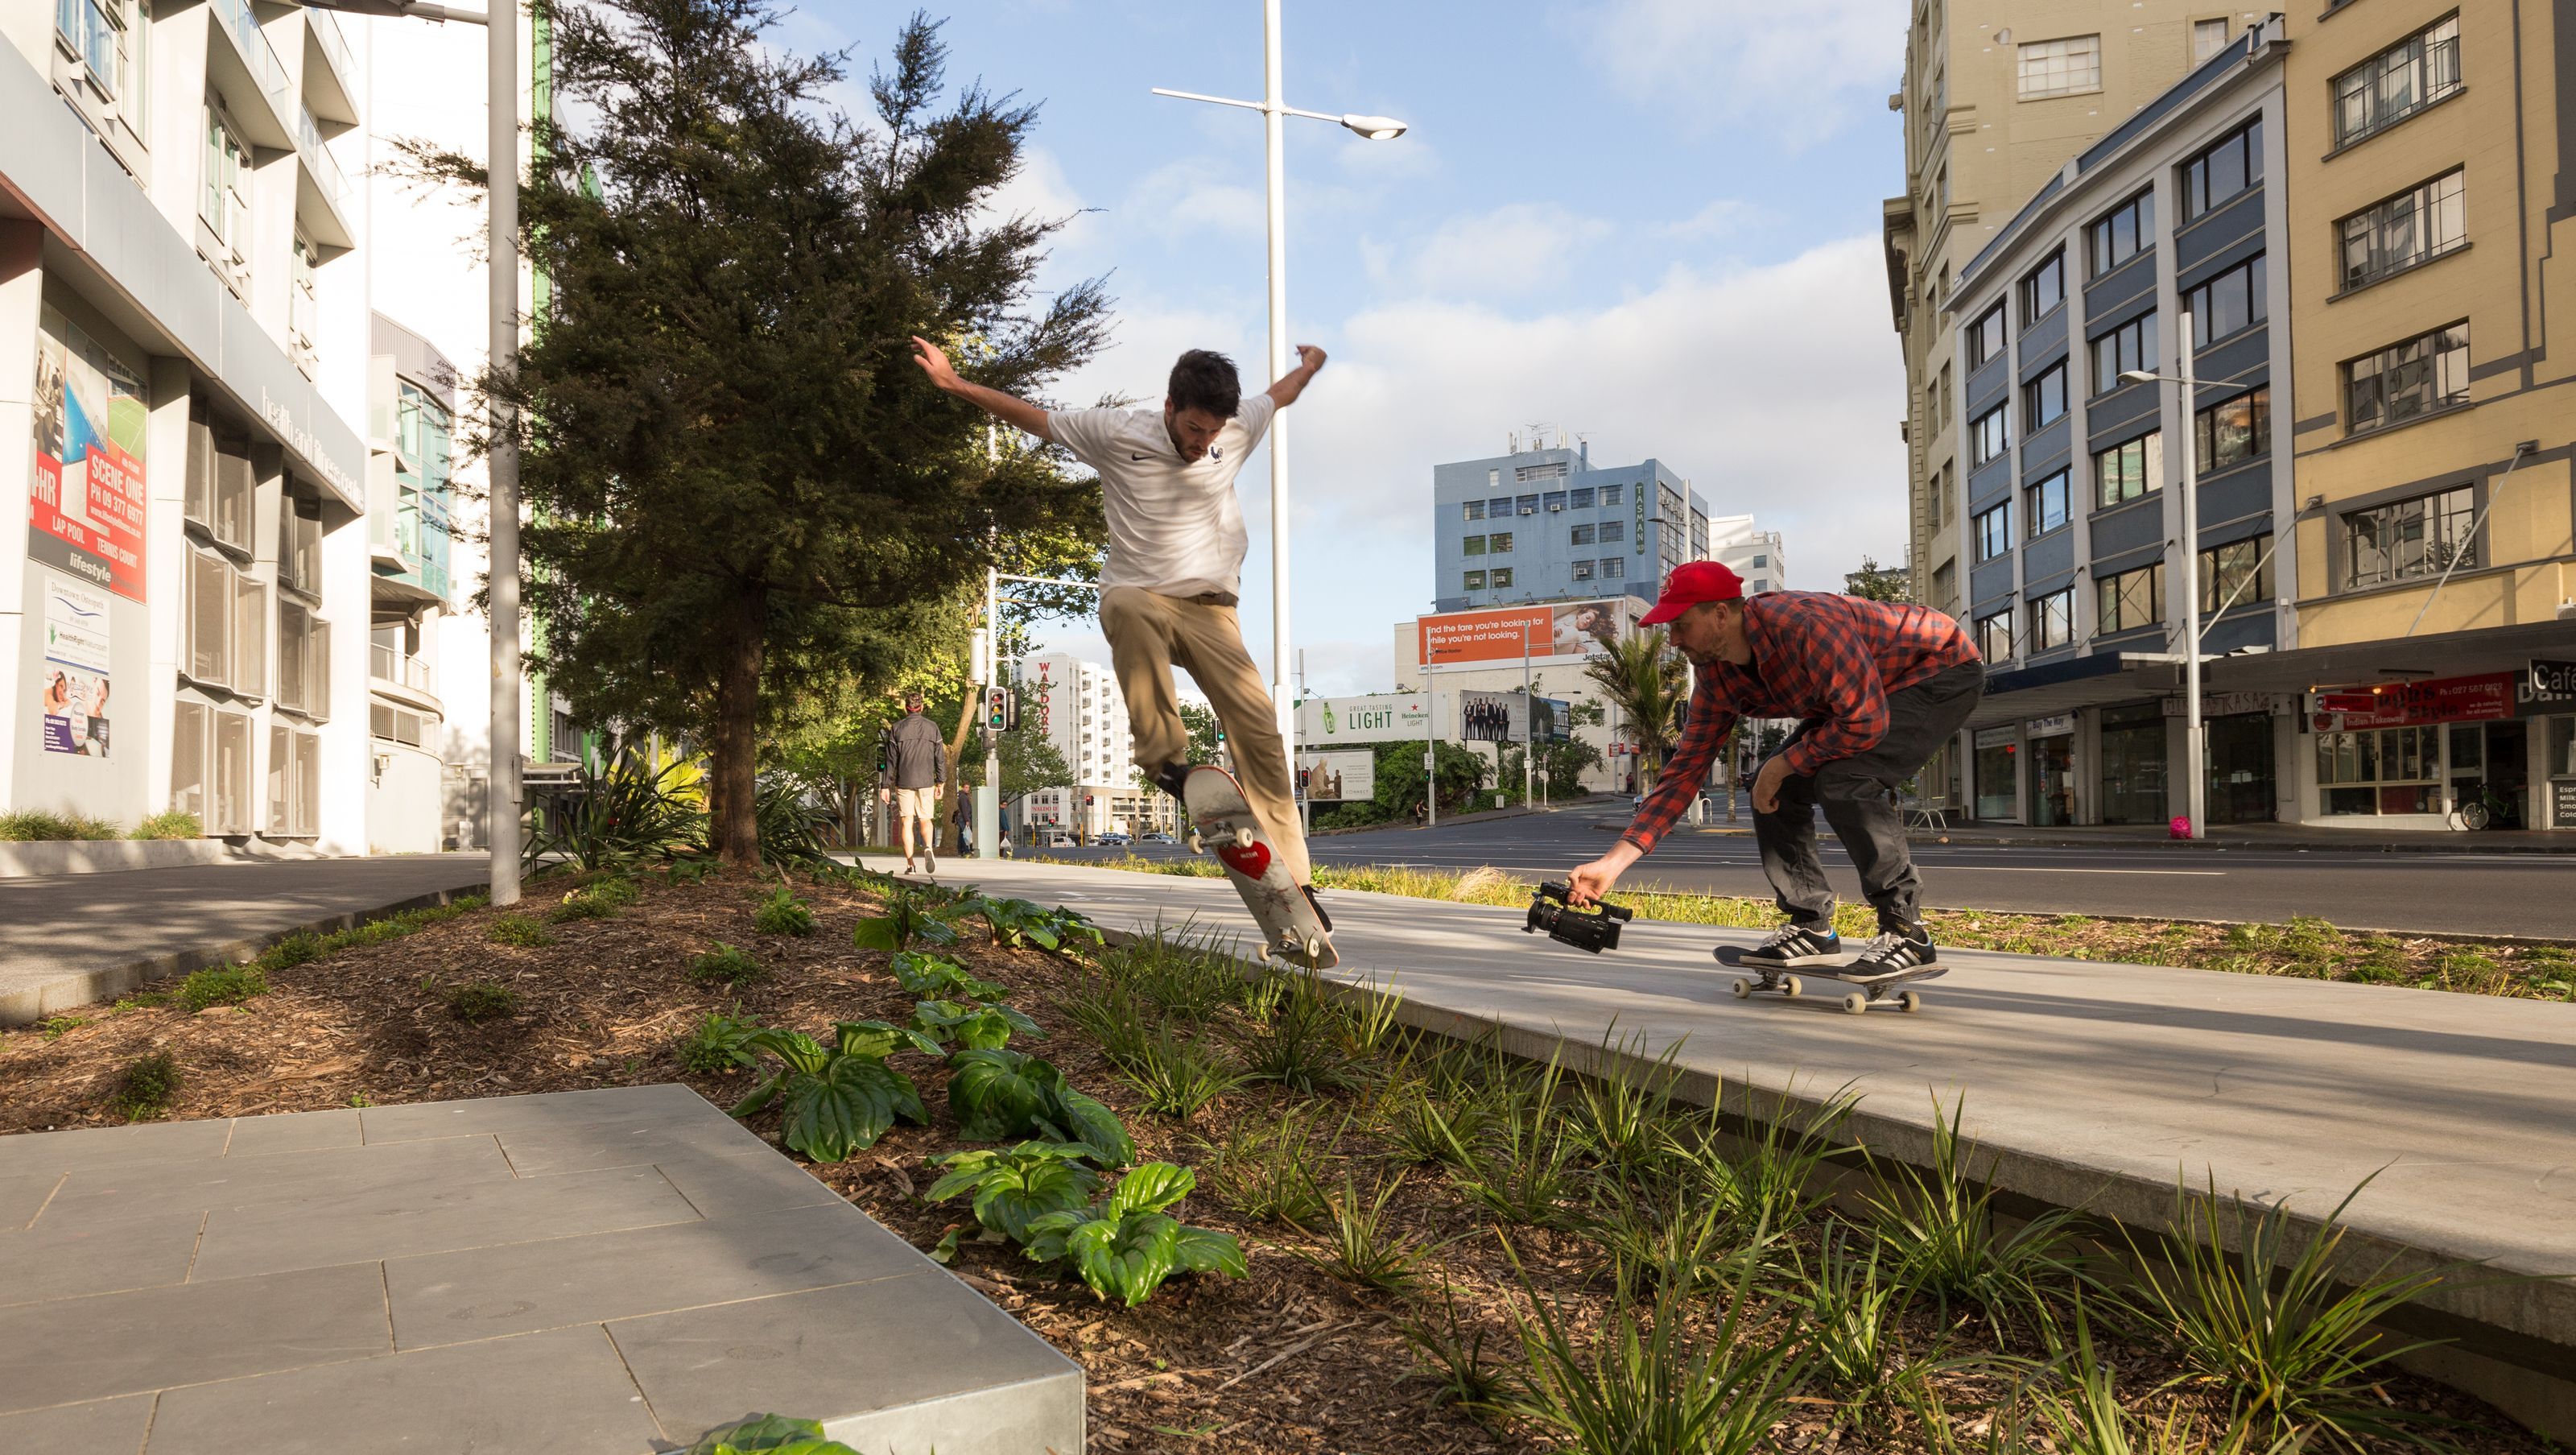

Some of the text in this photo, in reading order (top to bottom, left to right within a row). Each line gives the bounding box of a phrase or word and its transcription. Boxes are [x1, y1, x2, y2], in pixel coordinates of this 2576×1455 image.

[262, 386, 293, 444] health
[314, 439, 341, 488] fitness
[92, 454, 143, 506] SCENE ONE
[91, 482, 143, 526] PH 09 377 6977
[52, 515, 85, 544] LAP POOL
[97, 536, 138, 568] TENNIS COURT
[1426, 626, 1442, 634] Fnd
[1443, 625, 1455, 633] the
[1458, 623, 1472, 631] fare
[1476, 622, 1498, 631] you're
[1501, 619, 1531, 628] looking
[1448, 634, 1472, 644] you're
[1474, 633, 1486, 641] not
[1488, 631, 1520, 641] looking.
[1349, 711, 1393, 730] LIGHT
[2033, 721, 2042, 730] Buy
[2043, 719, 2053, 727] The
[2347, 715, 2405, 726] Indian Takeaway
